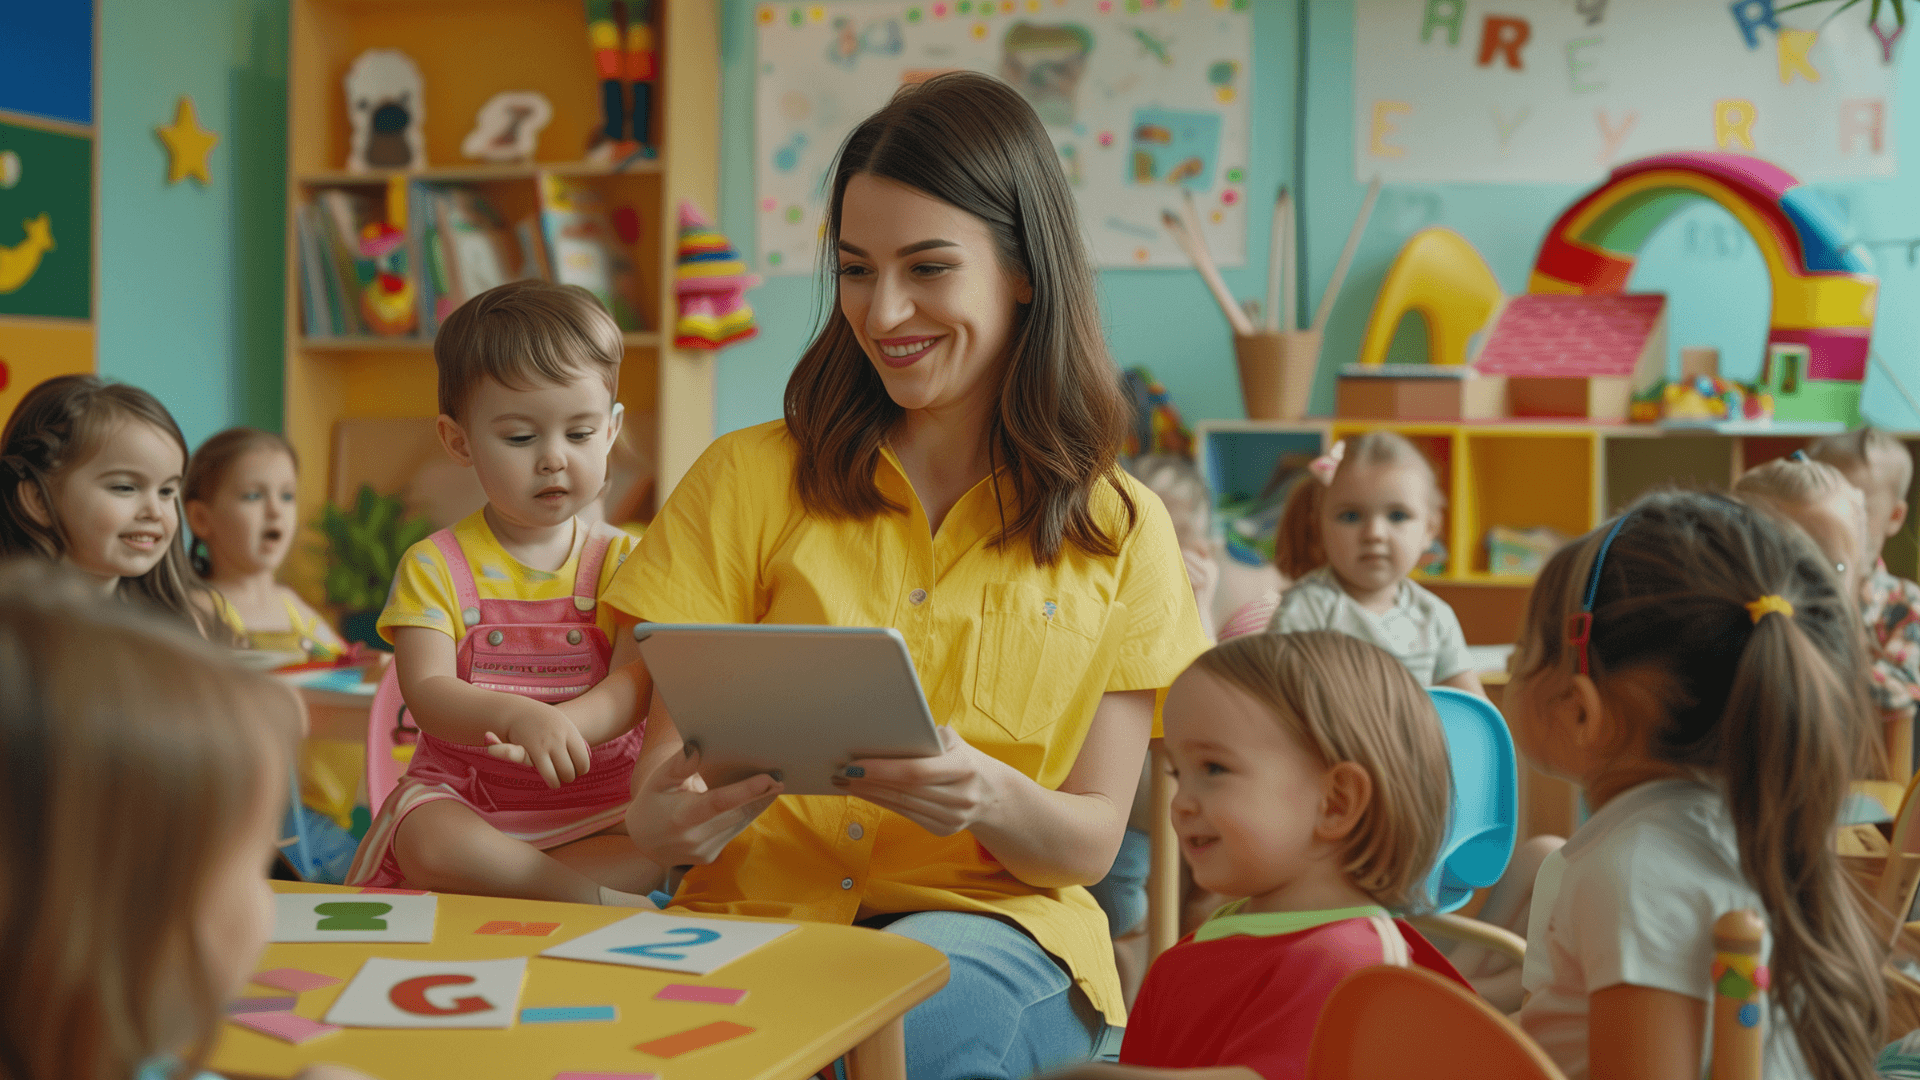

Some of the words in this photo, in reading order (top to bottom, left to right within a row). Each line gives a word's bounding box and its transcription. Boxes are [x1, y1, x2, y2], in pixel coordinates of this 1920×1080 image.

[1476, 15, 1531, 70] R
[1729, 0, 1780, 50] R
[1776, 28, 1822, 87] K
[1368, 100, 1413, 158] E
[1713, 98, 1757, 150] R
[606, 927, 724, 961] 2
[388, 973, 498, 1018] G
